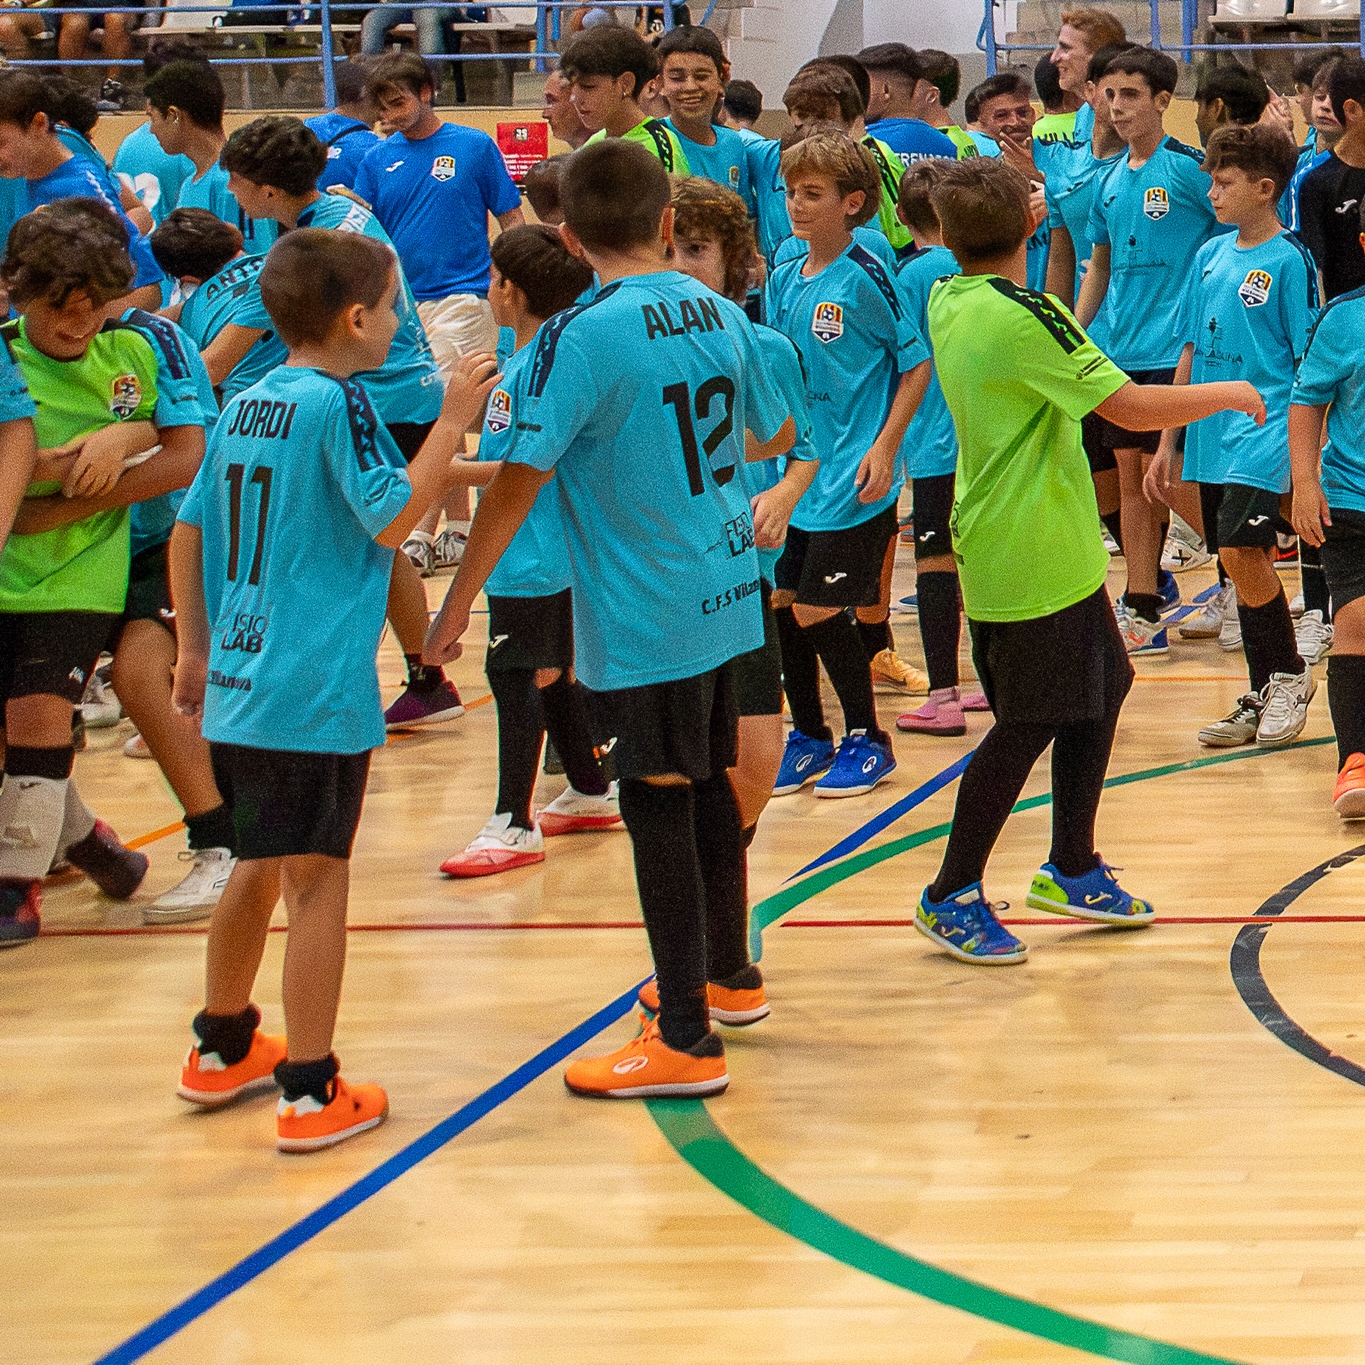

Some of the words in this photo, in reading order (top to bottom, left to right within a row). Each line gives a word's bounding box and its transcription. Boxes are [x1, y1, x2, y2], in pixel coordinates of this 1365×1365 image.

[642, 297, 725, 340] ALAN
[228, 399, 298, 439] JORDI
[663, 376, 735, 497] 12
[224, 463, 273, 586] 11
[702, 589, 732, 614] C.F.S
[221, 629, 264, 653] LAB
